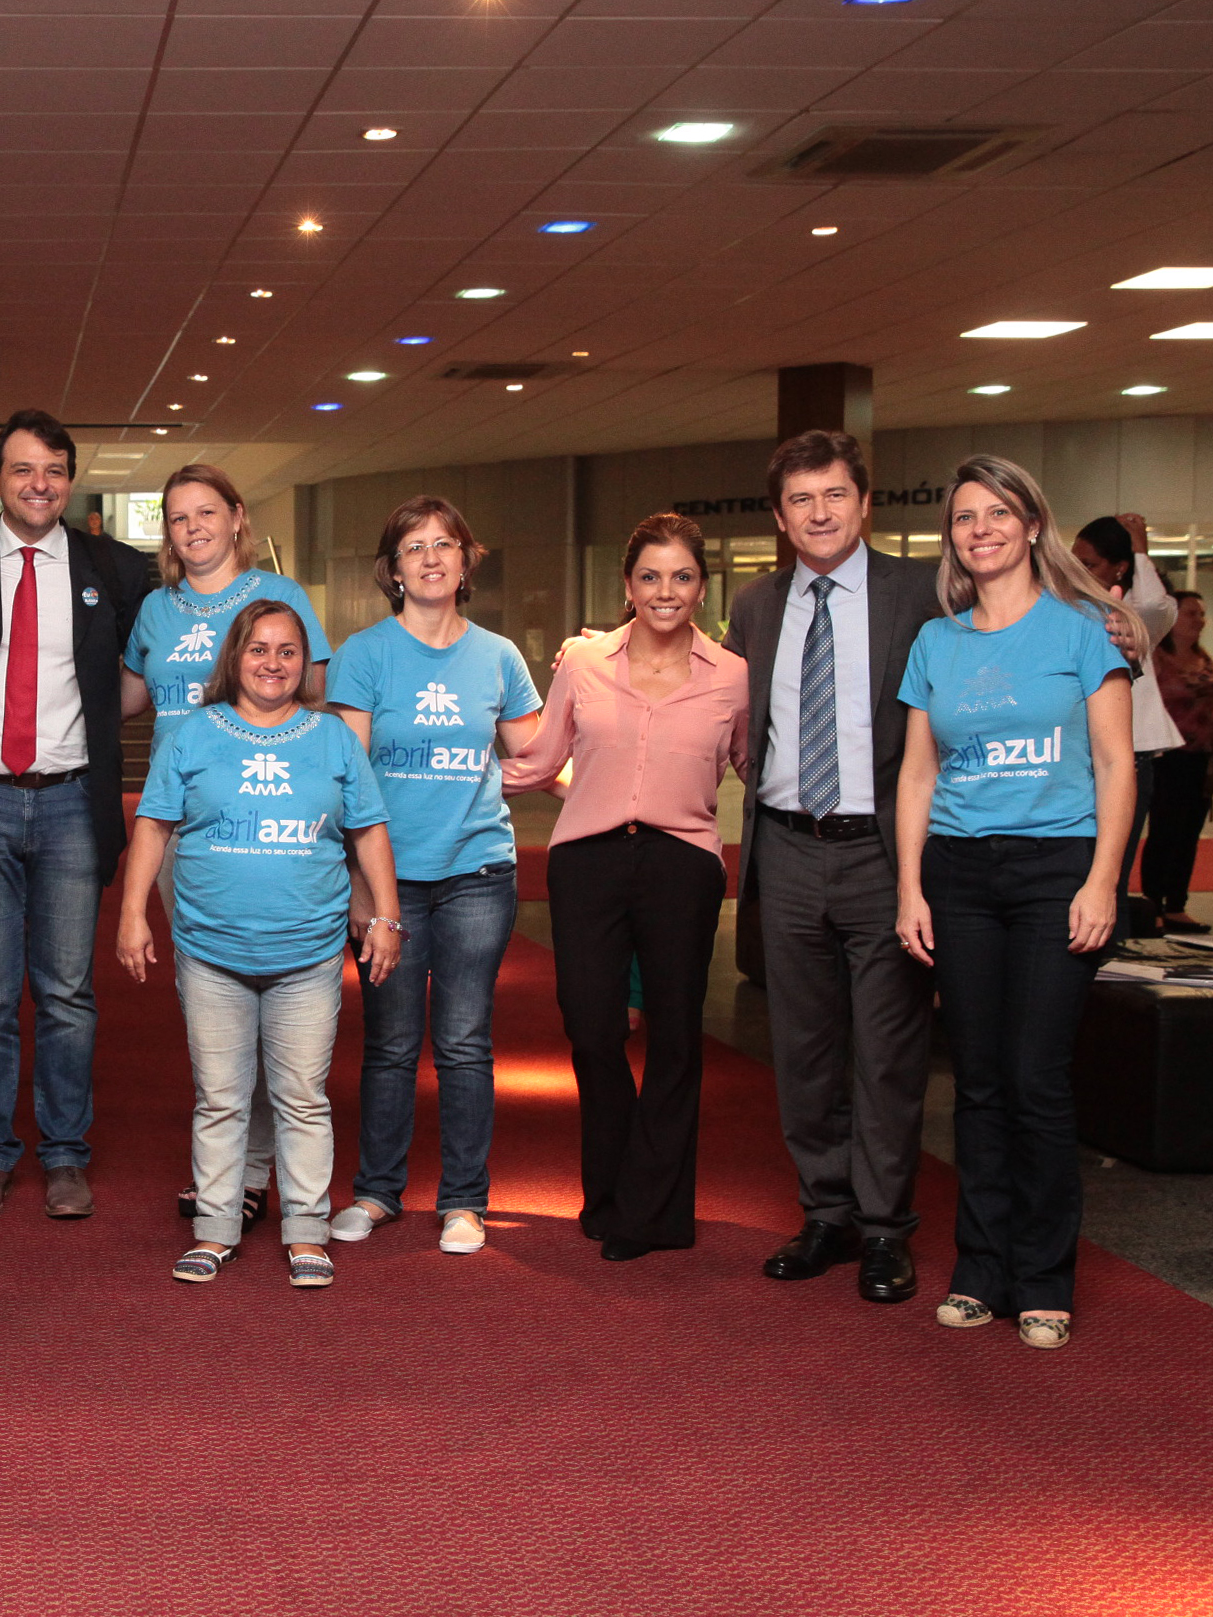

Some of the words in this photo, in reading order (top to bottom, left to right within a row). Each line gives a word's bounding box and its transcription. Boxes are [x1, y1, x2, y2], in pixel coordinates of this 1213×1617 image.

[673, 496, 773, 515] CENTRO
[166, 650, 213, 662] AMA
[413, 713, 465, 726] AMA
[384, 771, 407, 779] Acenda
[423, 772, 433, 780] luz
[238, 781, 293, 796] AMA
[209, 844, 231, 853] Acenda
[249, 846, 261, 855] luz
